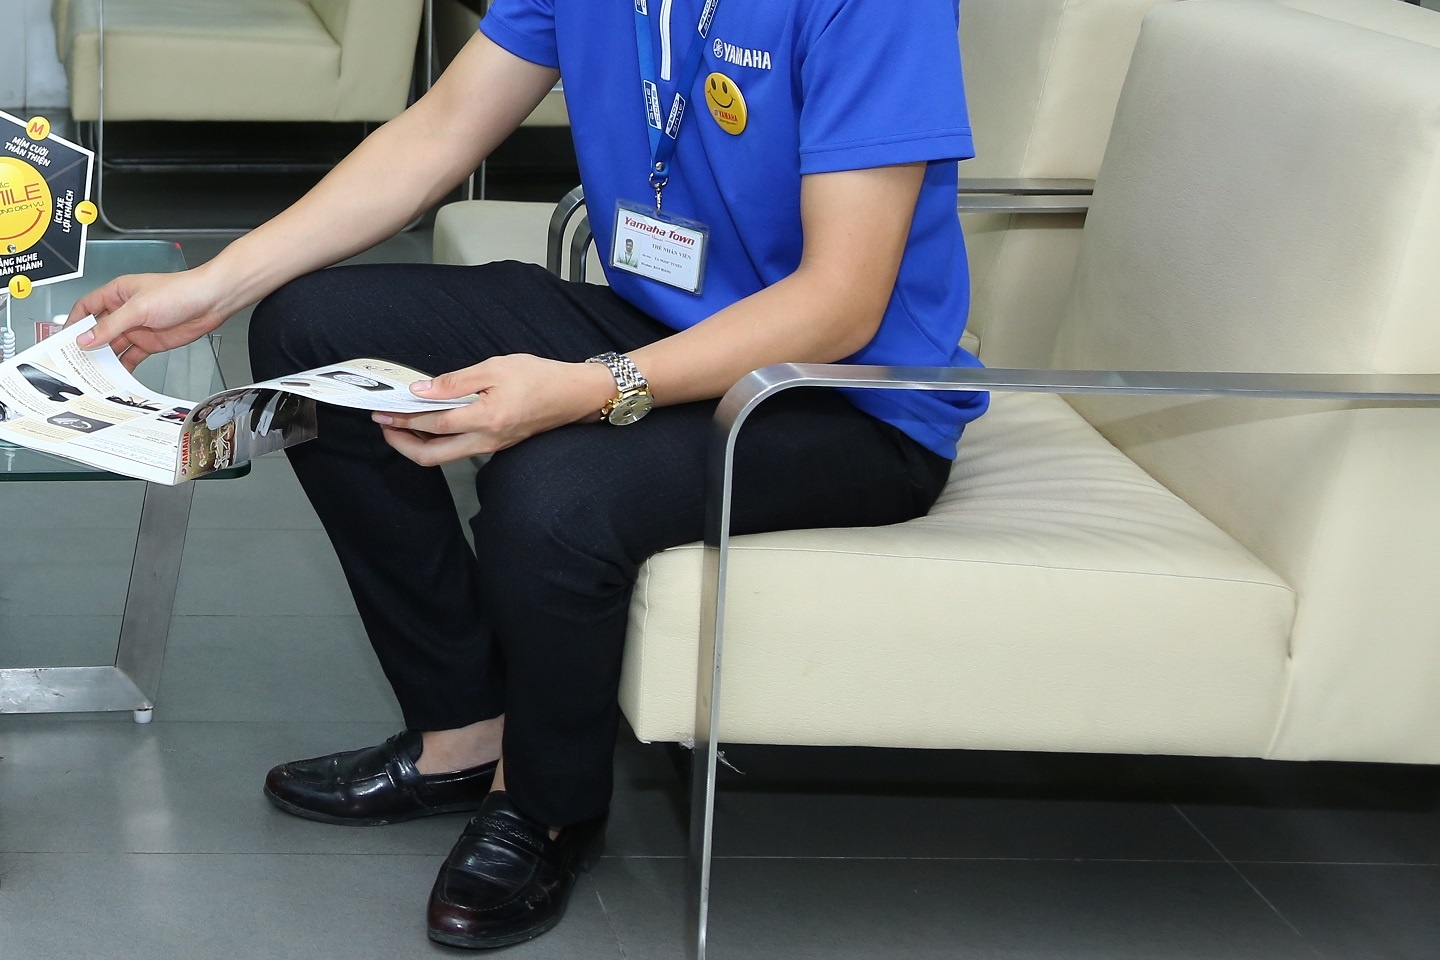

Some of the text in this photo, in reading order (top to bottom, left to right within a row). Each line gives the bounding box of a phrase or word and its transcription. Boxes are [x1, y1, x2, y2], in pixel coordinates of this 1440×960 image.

[724, 42, 771, 70] YAMAHA
[718, 109, 738, 122] YAMAHA
[29, 122, 44, 135] M
[5, 142, 51, 168] THÂN THIỆN
[30, 143, 49, 158] CƯỜI
[14, 203, 33, 216] DỊCH
[33, 201, 44, 211] VỤ
[53, 197, 65, 224] ÍCH XE
[62, 190, 74, 233] LỢI KHÁCH
[625, 216, 695, 246] Yamaha Town
[16, 252, 38, 265] NGHE
[14, 259, 43, 274] THÀNH
[17, 281, 25, 293] L
[181, 431, 190, 468] YAMAHA
